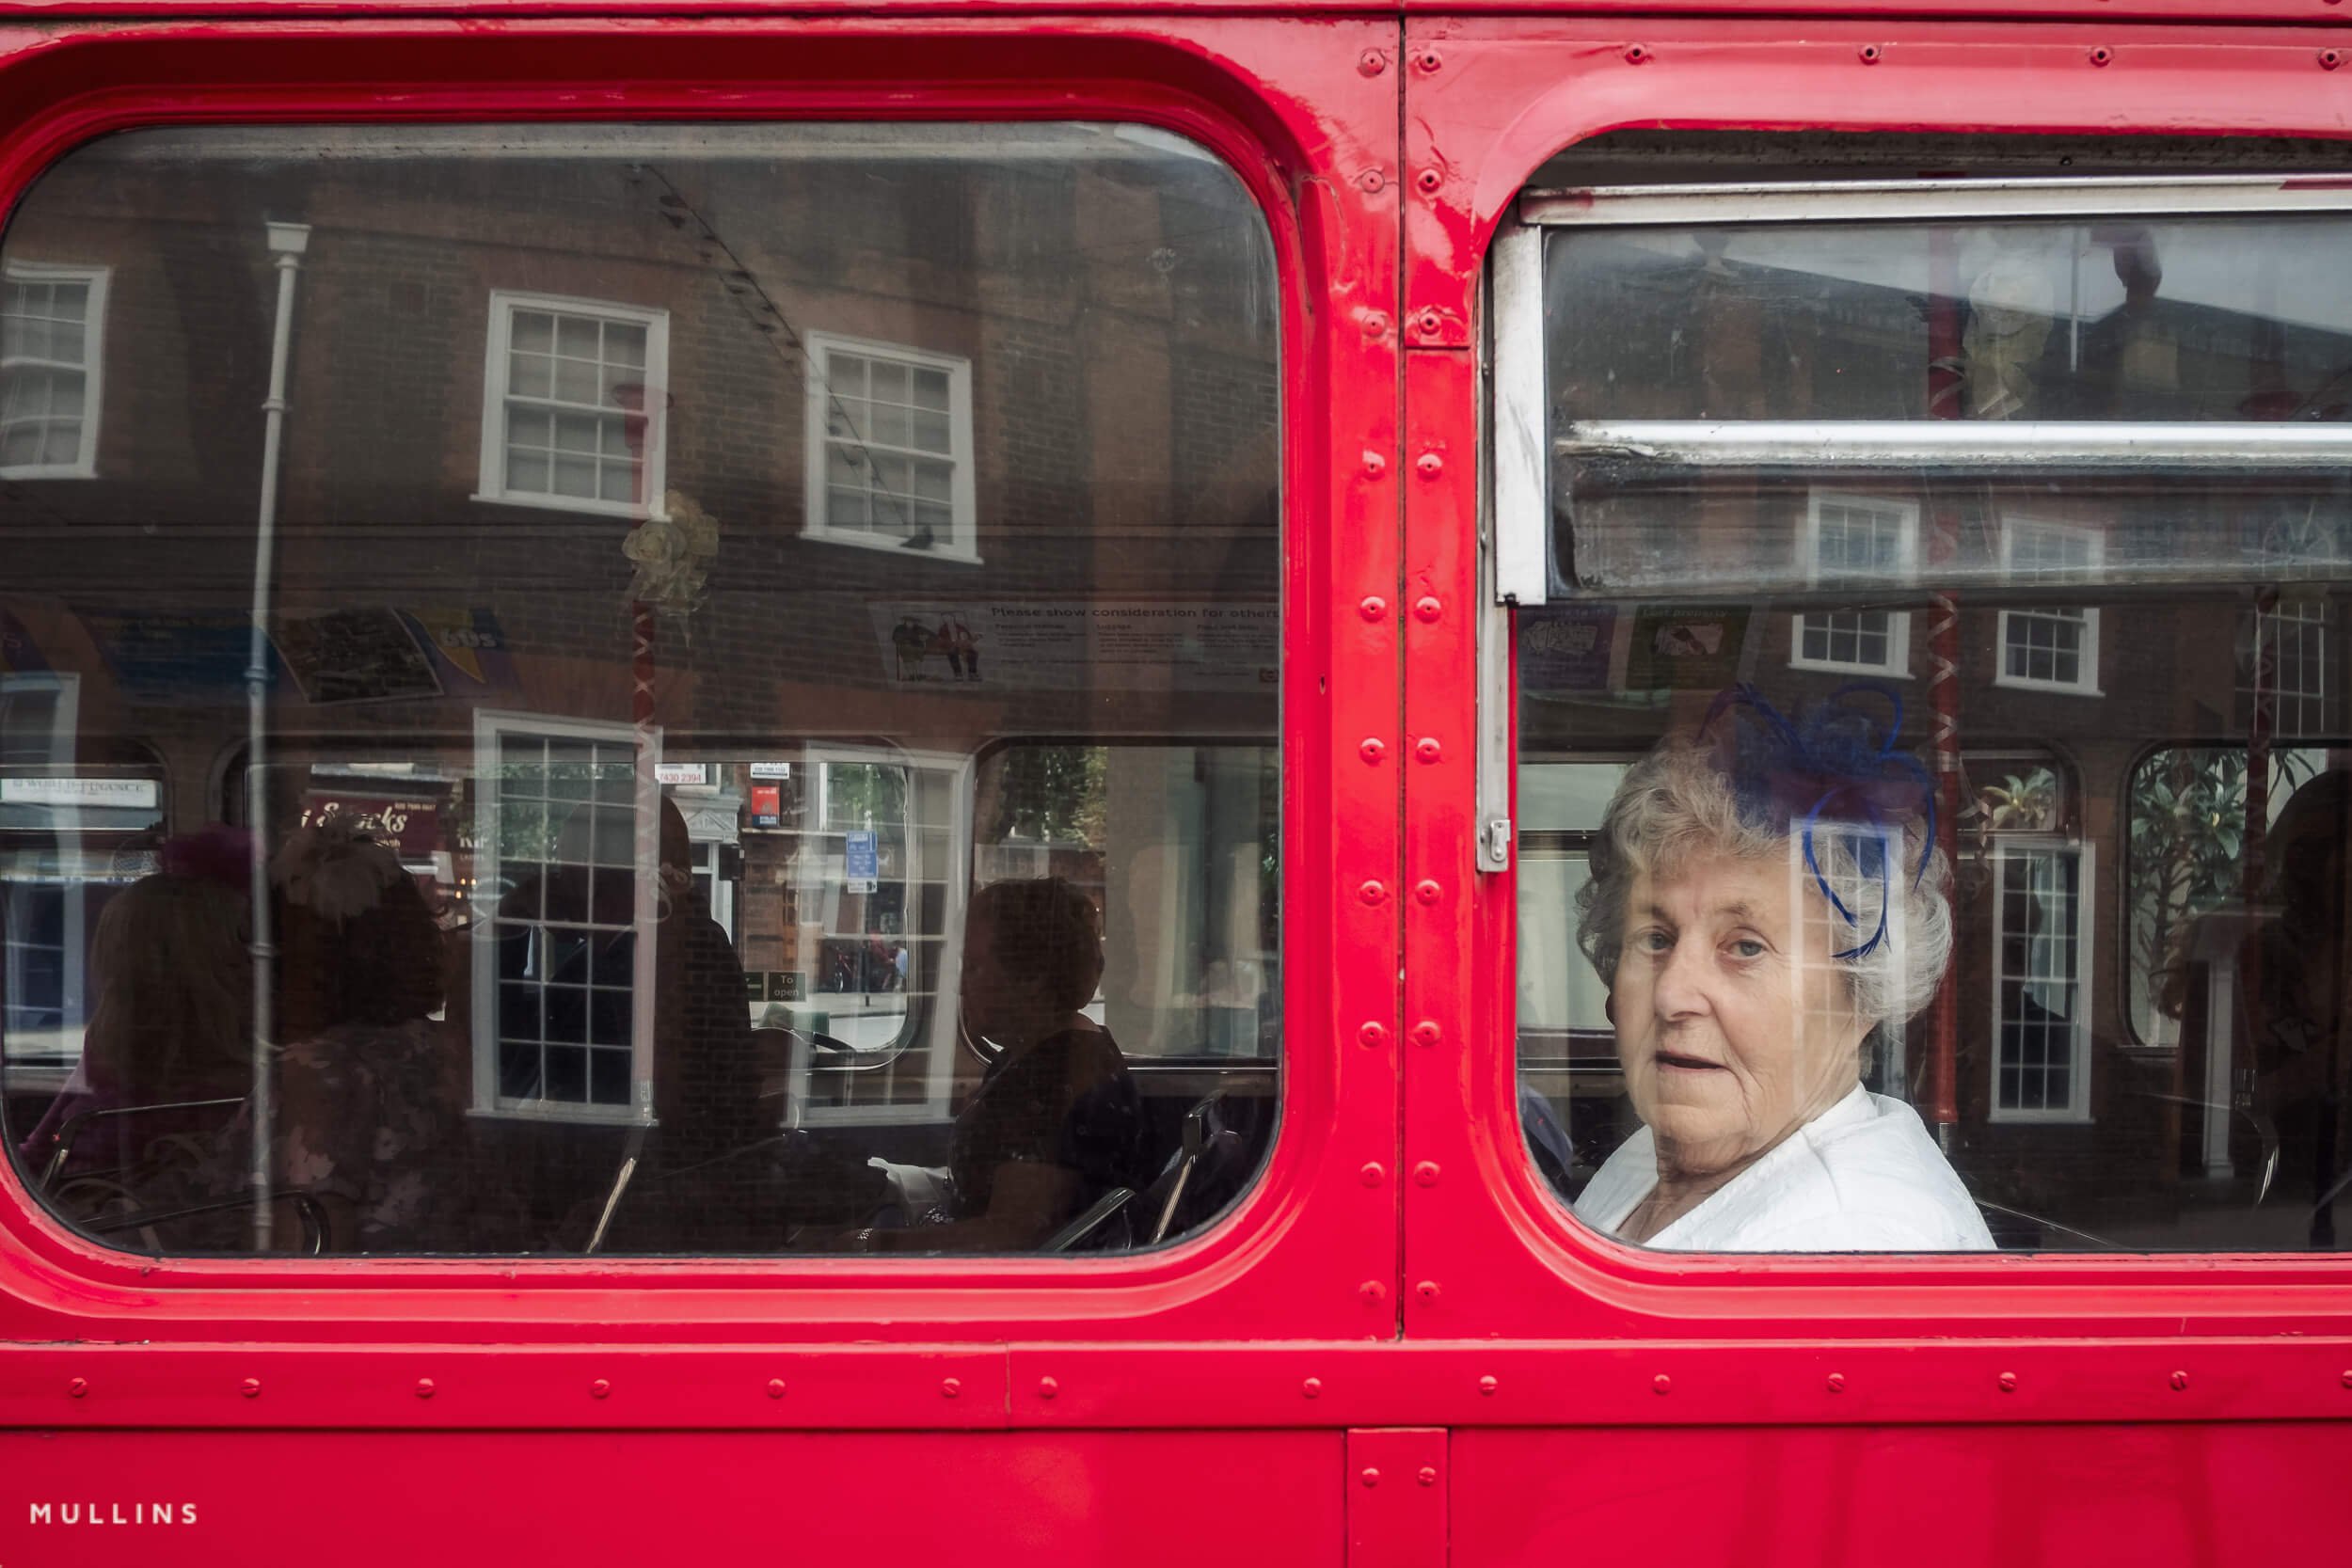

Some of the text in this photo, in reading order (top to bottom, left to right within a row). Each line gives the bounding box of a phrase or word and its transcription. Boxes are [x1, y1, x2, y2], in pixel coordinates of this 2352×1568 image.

[991, 607, 1041, 617] Please
[1045, 607, 1086, 617] show
[1091, 607, 1197, 617] consideration
[1201, 608, 1223, 618] for
[780, 974, 794, 985] To
[773, 989, 799, 998] open
